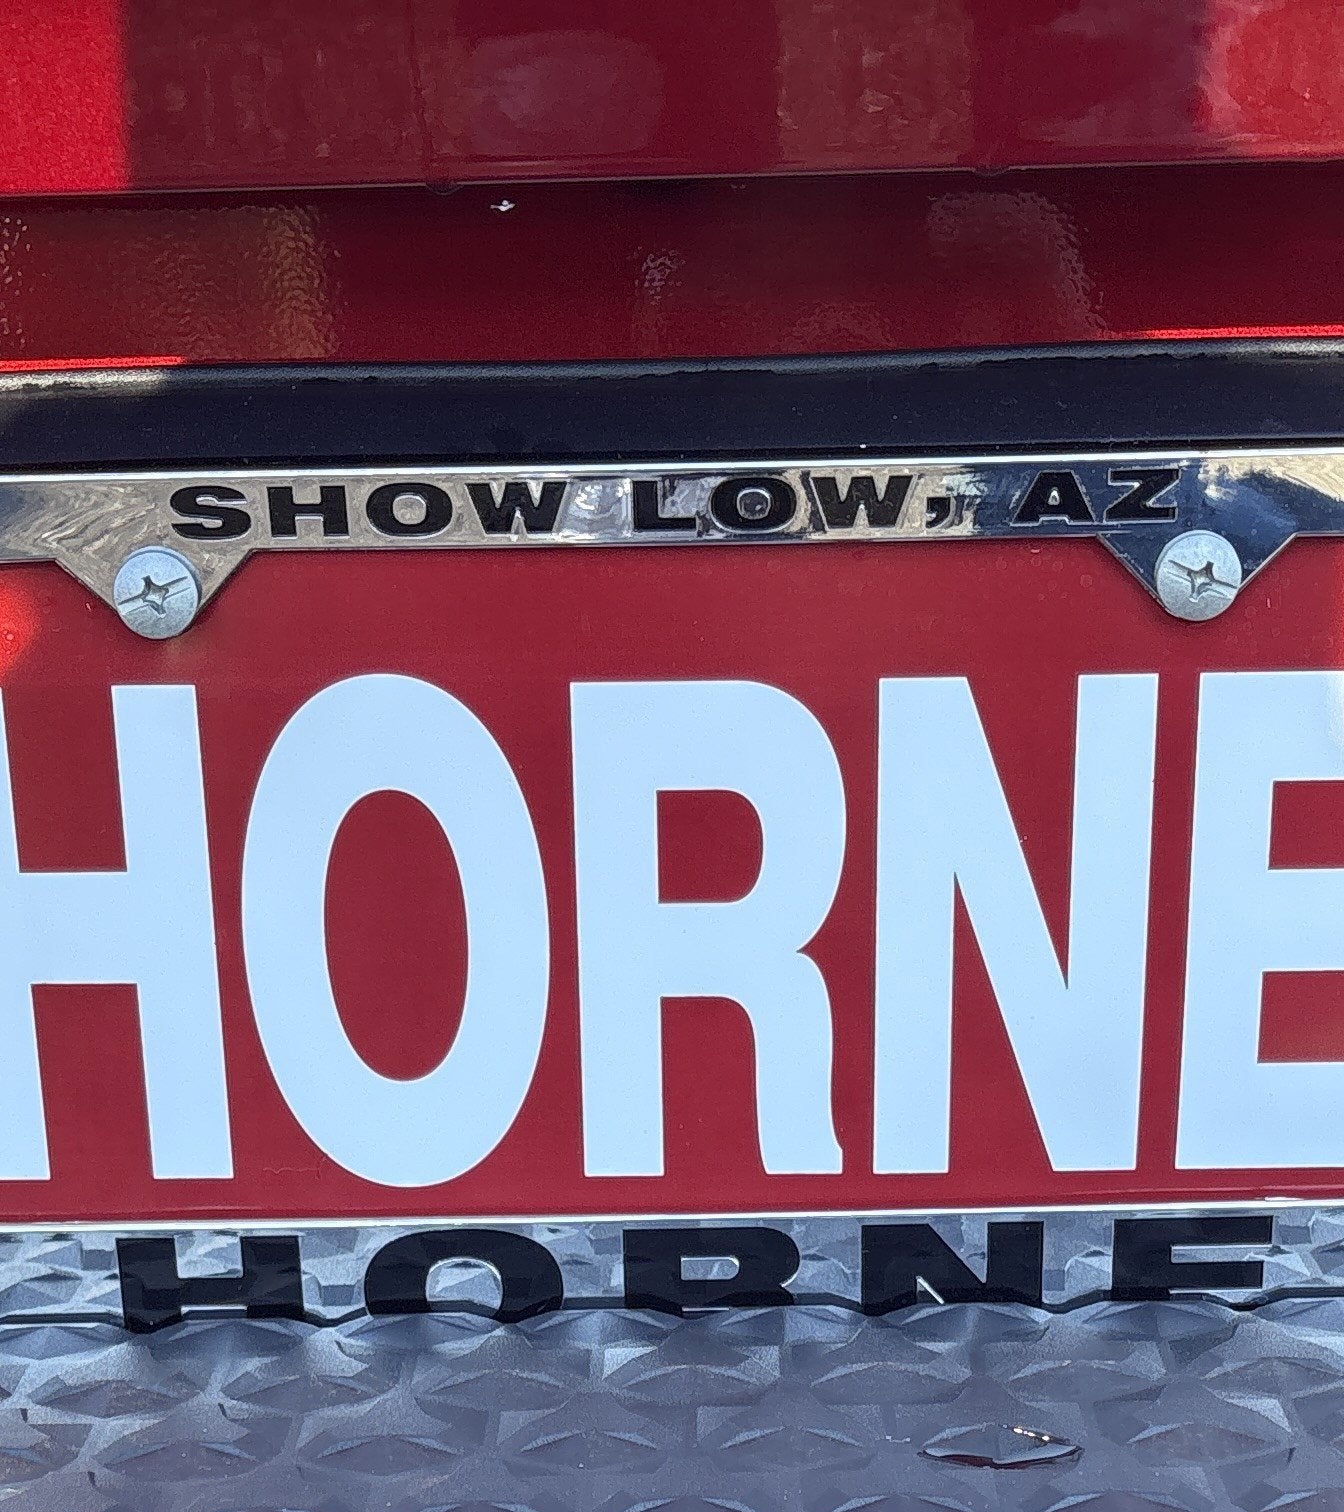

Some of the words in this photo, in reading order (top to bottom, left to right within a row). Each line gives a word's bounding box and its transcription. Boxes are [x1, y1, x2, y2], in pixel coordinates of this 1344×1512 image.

[169, 480, 568, 540] SHOW
[632, 474, 956, 533] LOW,
[1011, 468, 1180, 525] AZ
[115, 1215, 1274, 1334] HORNE
